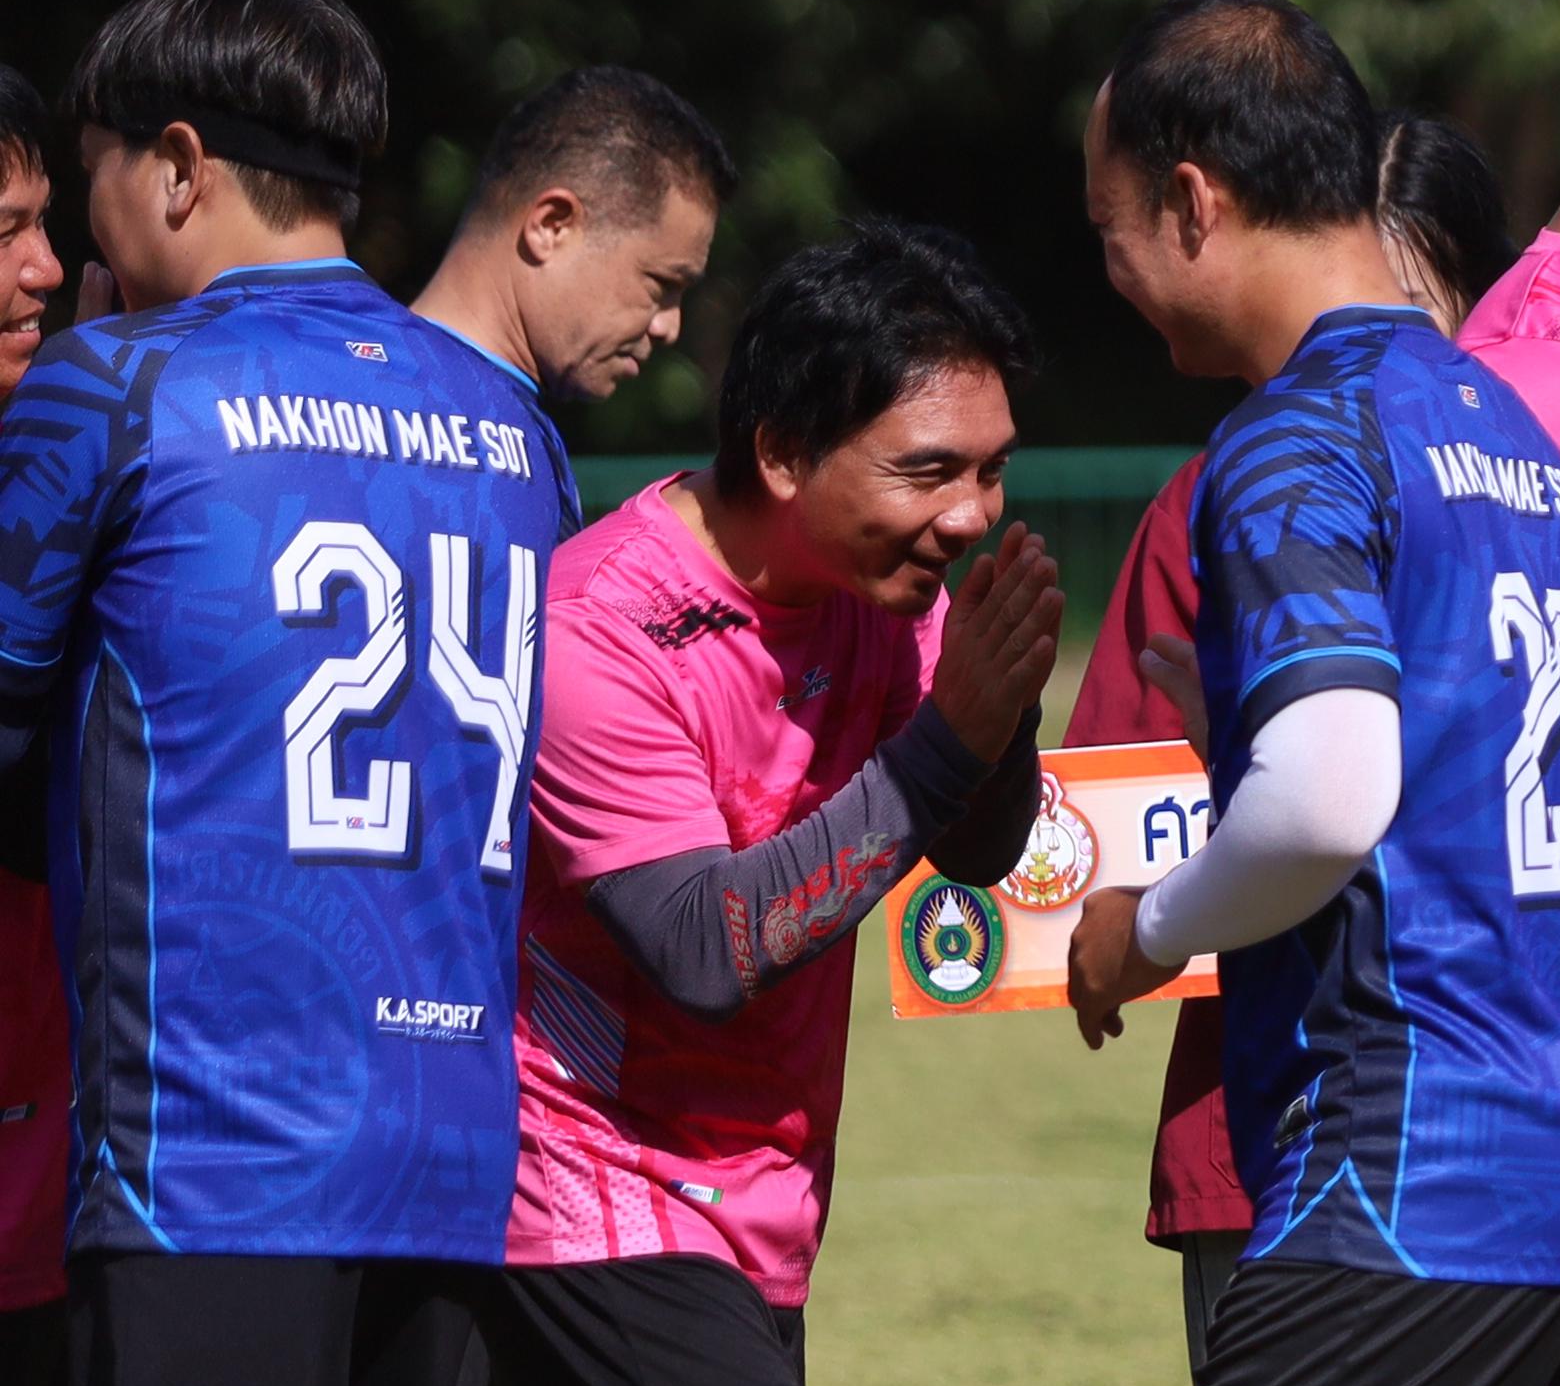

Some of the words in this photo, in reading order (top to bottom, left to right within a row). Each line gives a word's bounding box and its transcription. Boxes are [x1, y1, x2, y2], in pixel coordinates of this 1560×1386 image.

[217, 395, 389, 456] NAKHON
[393, 409, 479, 465] MAE
[478, 420, 531, 477] SOT
[1497, 456, 1550, 512] MAE
[272, 521, 536, 872] 24
[727, 897, 757, 999] HISPEE
